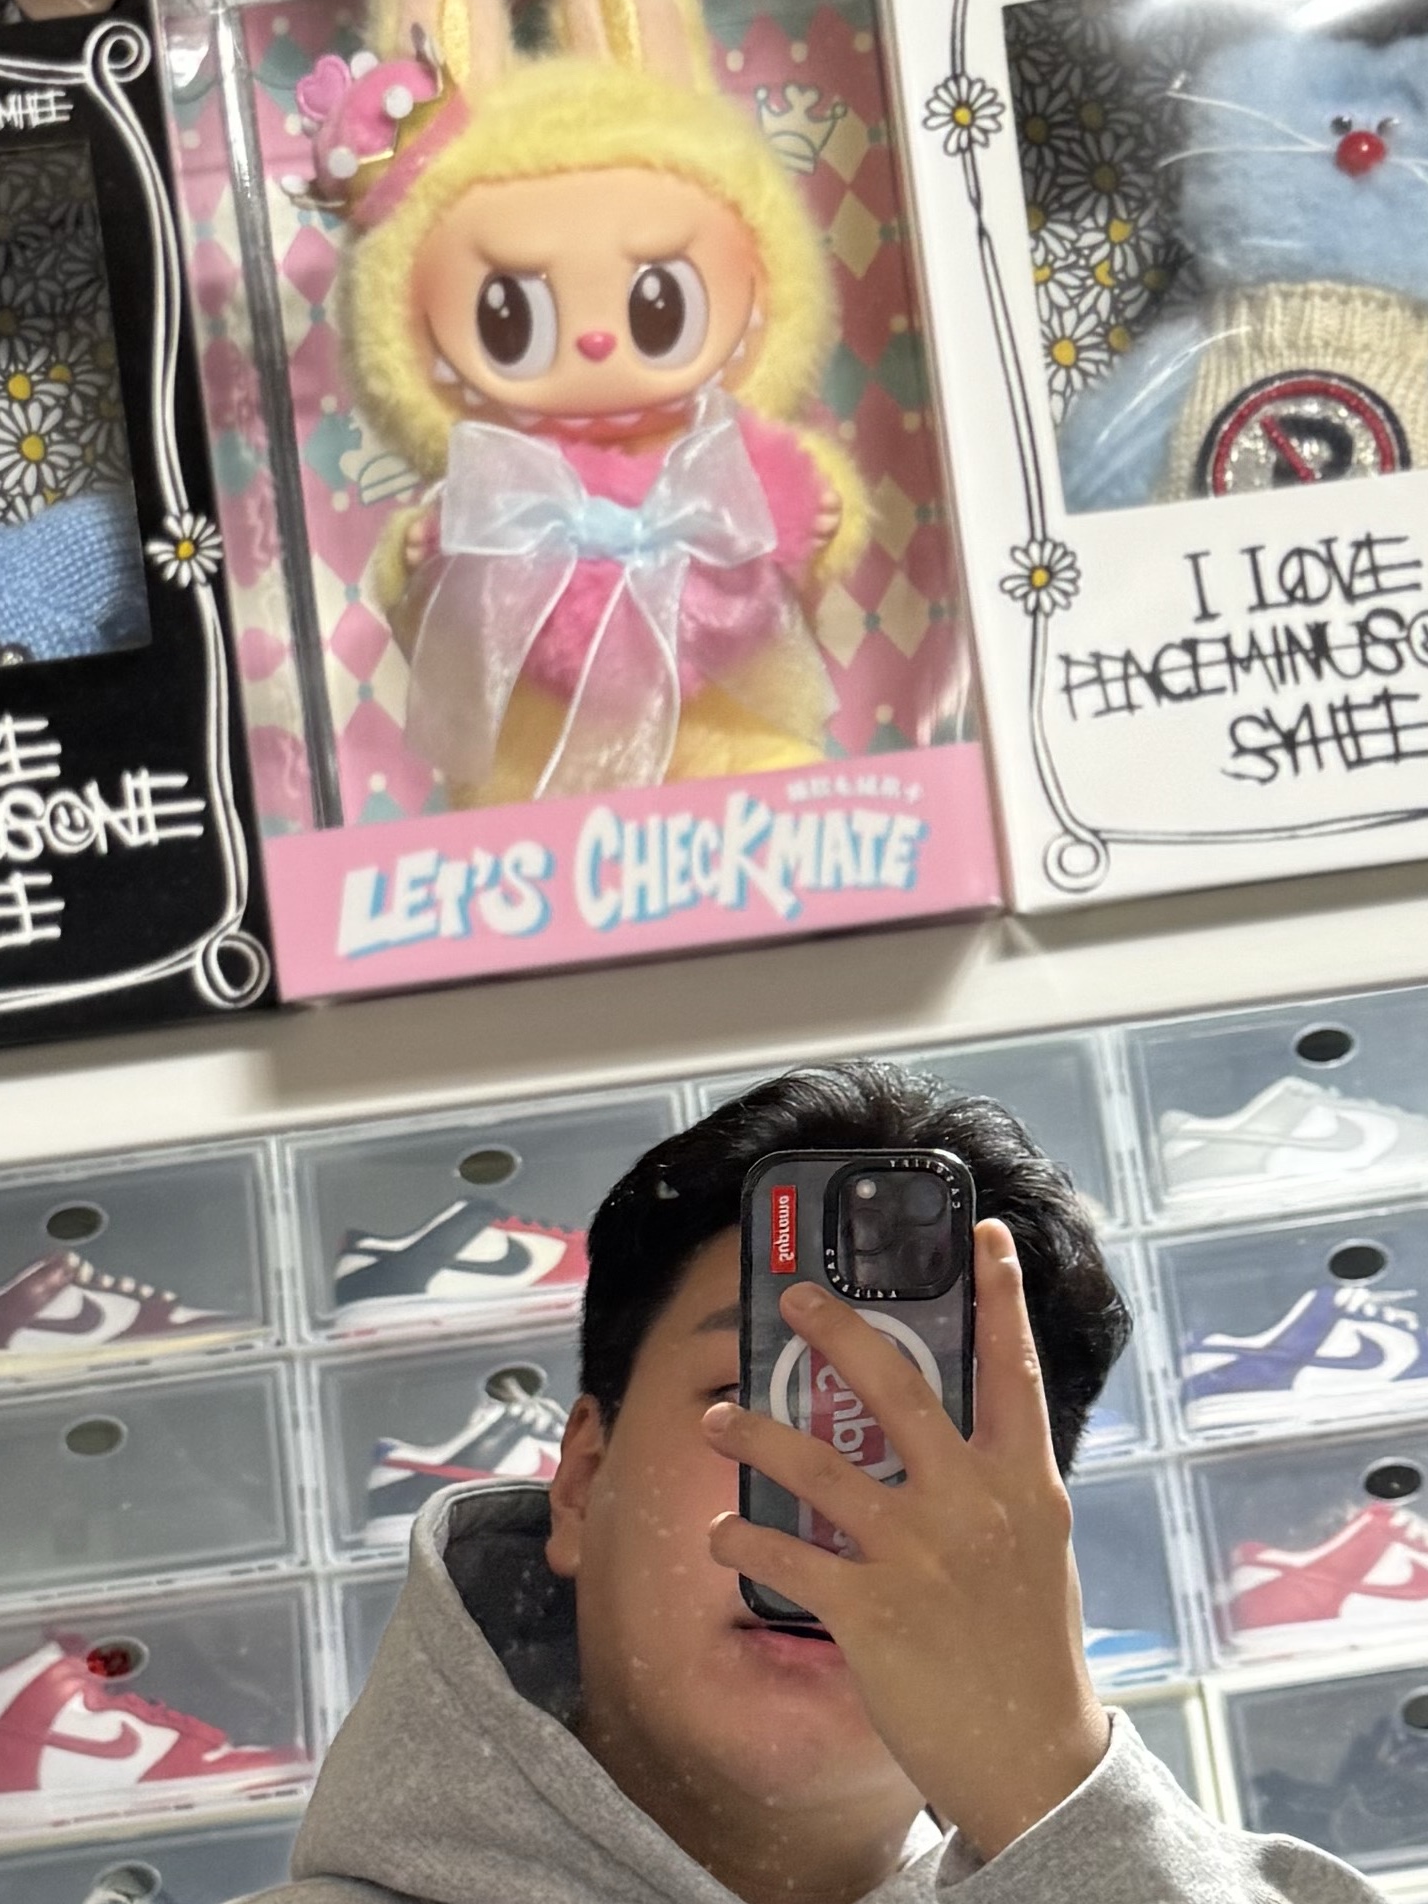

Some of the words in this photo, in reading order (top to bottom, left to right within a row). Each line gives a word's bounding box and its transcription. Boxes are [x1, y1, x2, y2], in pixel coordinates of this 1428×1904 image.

[1184, 550, 1222, 623] I
[1241, 532, 1424, 615] LOVE
[336, 839, 555, 958] LET'S
